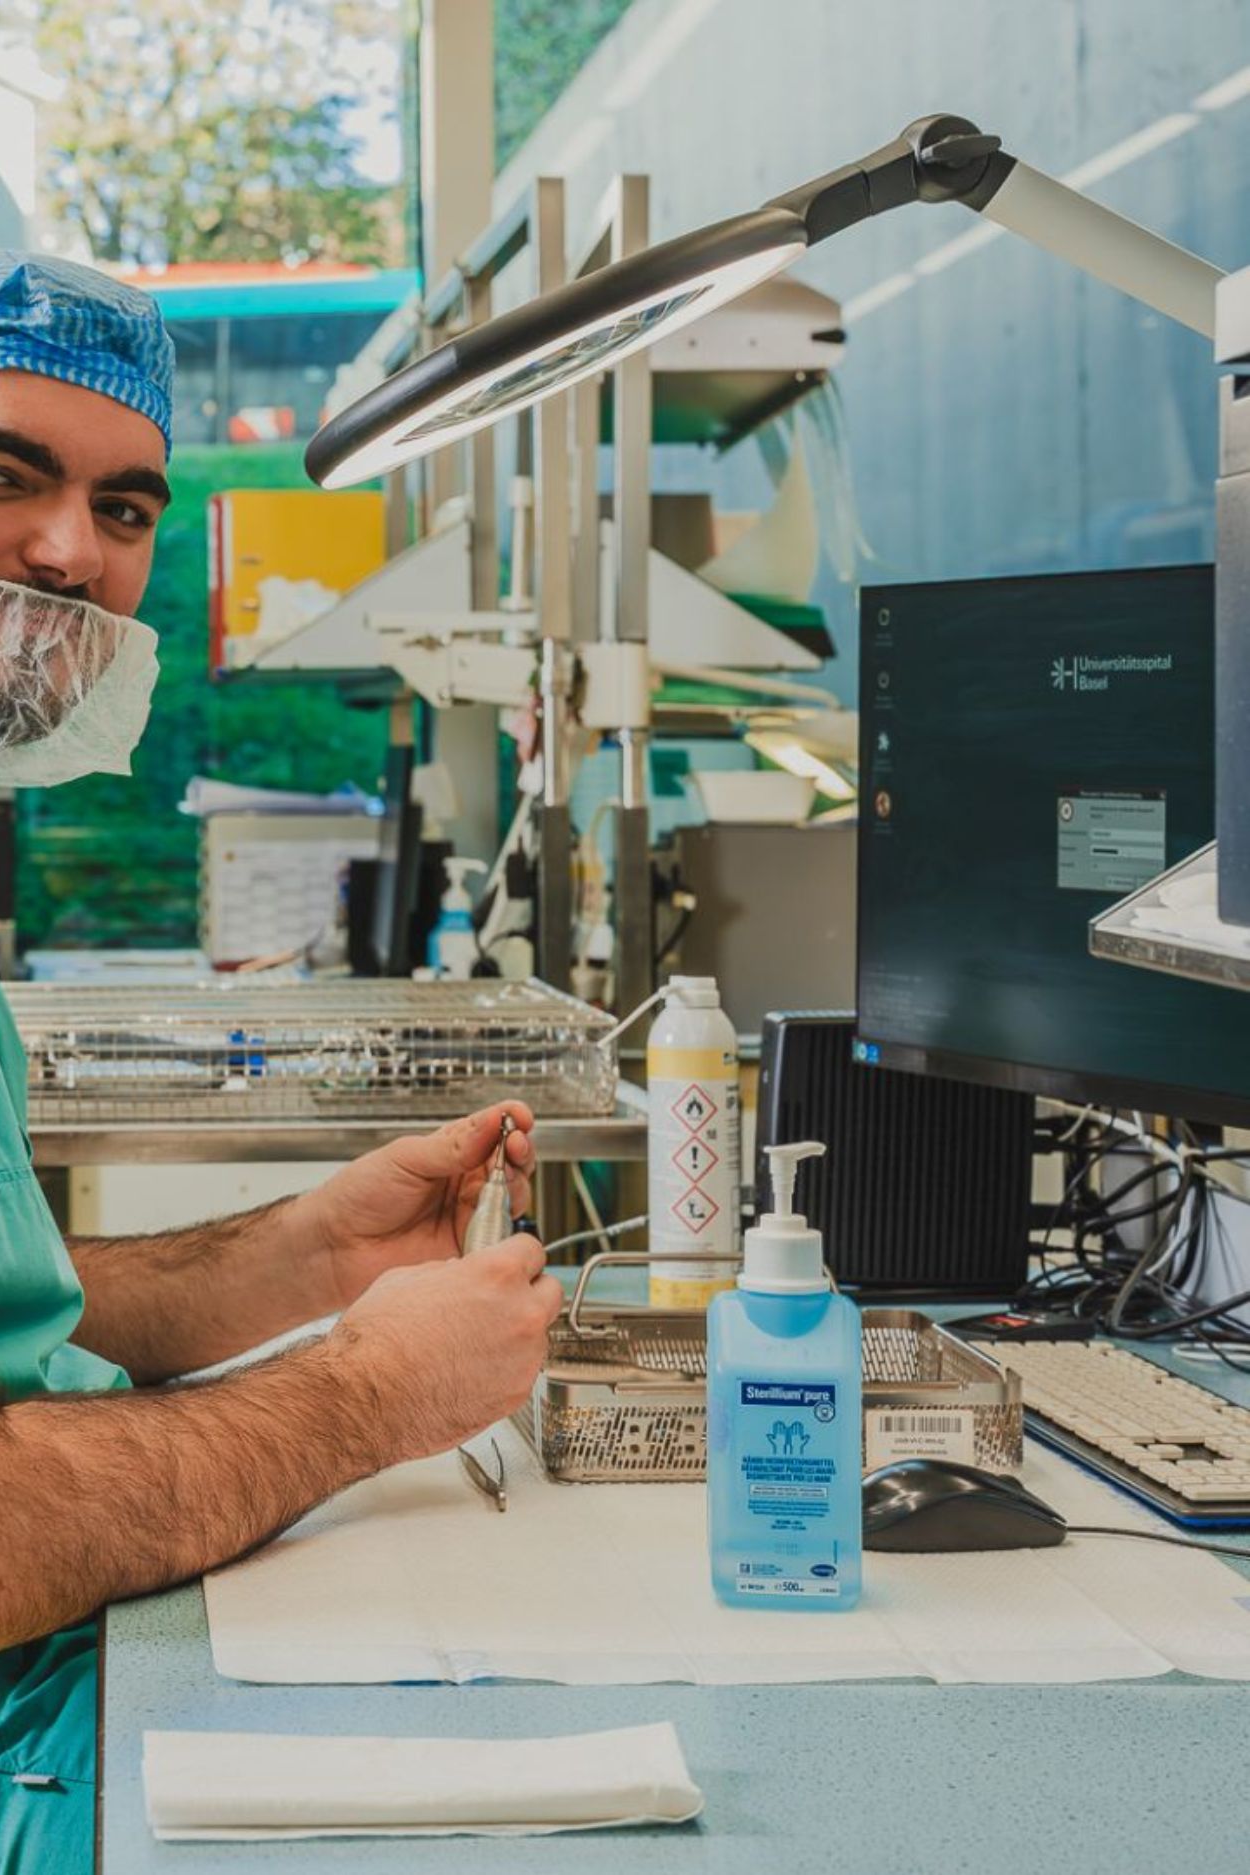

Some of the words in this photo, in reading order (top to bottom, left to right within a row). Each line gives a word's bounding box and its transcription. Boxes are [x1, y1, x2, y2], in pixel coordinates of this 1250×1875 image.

[1079, 653, 1172, 673] Universitätsspital
[1079, 675, 1108, 690] Basel
[803, 1390, 830, 1403] pure
[782, 1581, 799, 1593] 500
